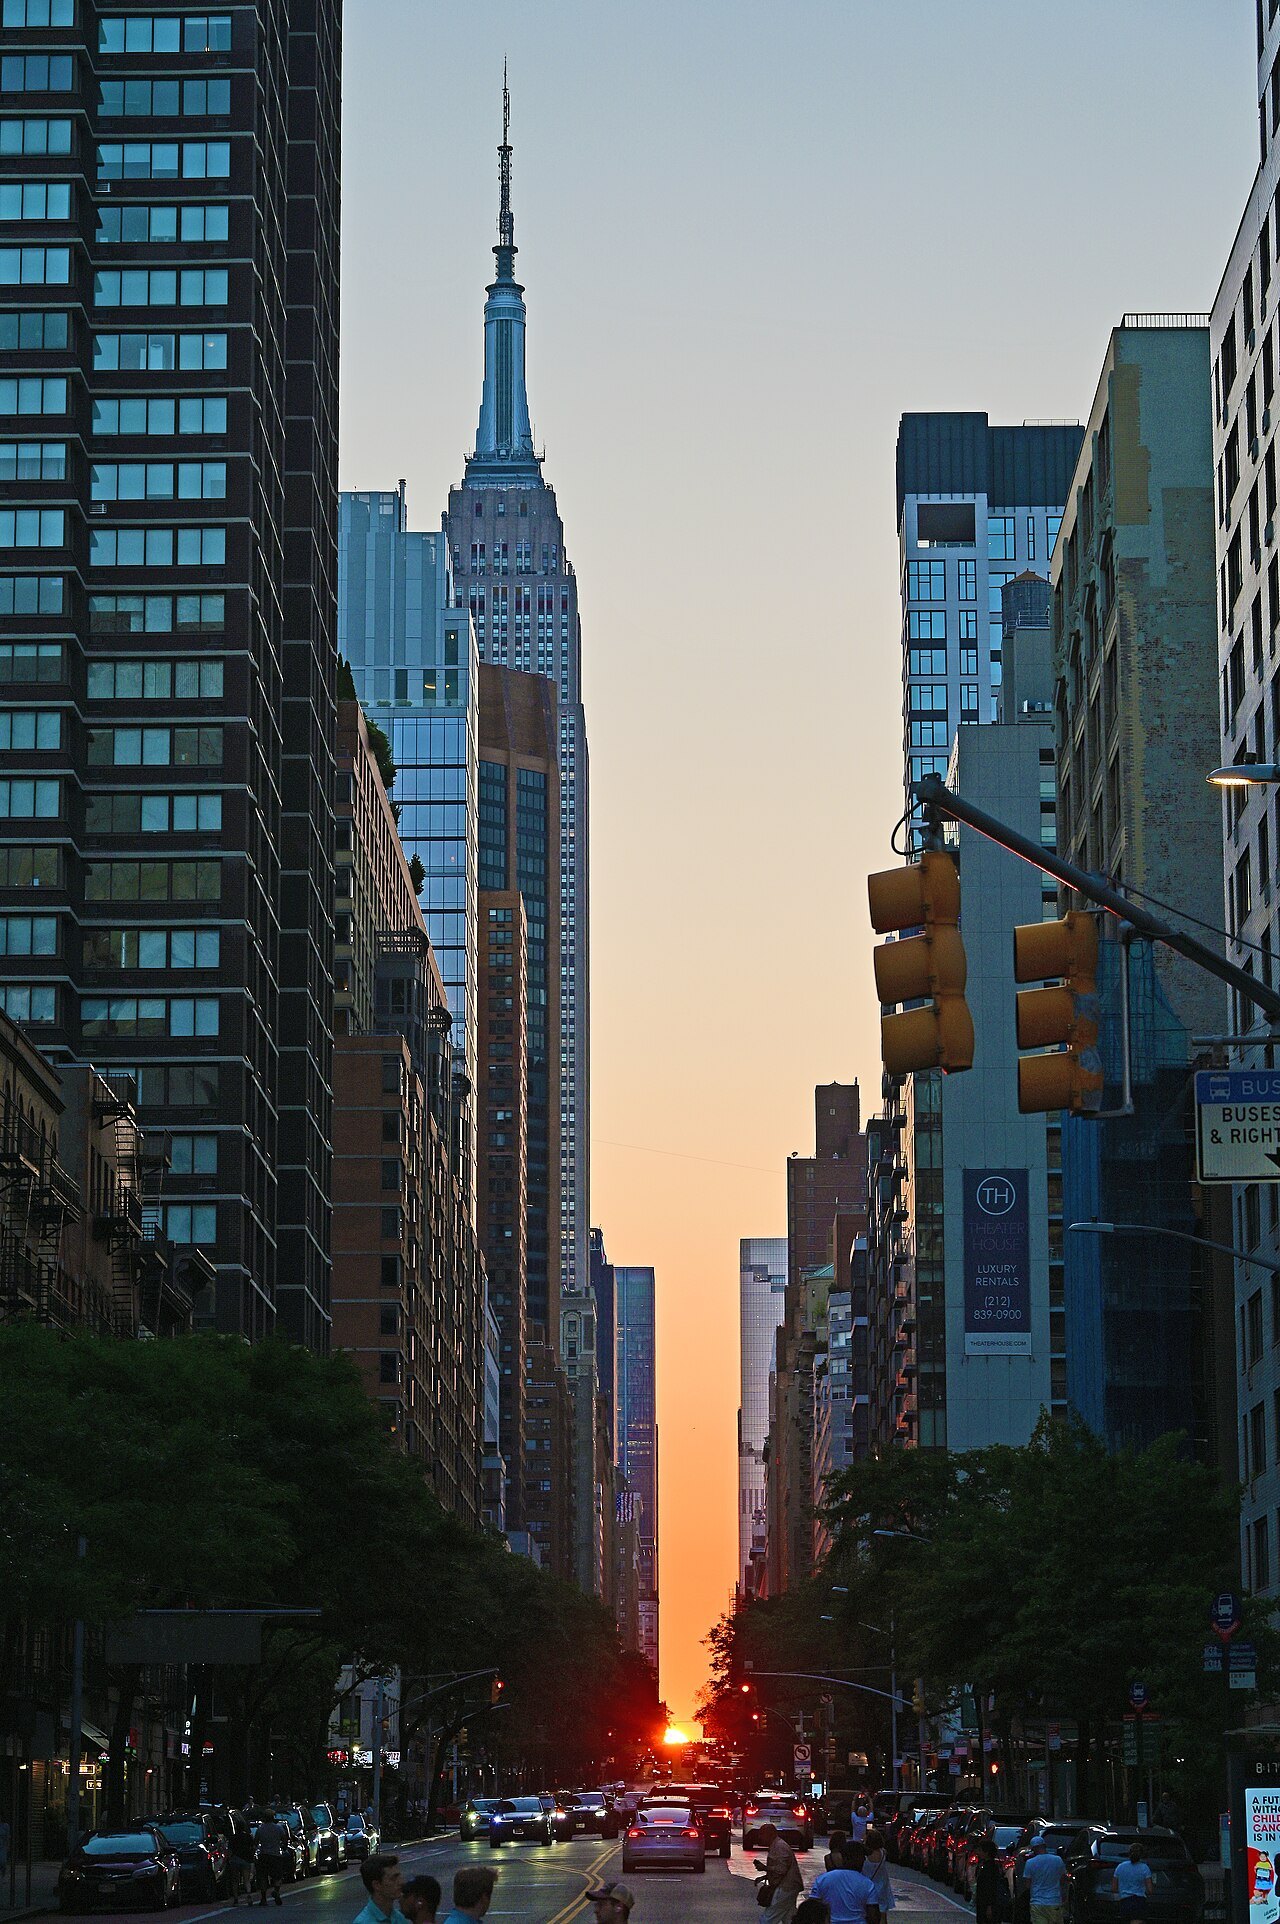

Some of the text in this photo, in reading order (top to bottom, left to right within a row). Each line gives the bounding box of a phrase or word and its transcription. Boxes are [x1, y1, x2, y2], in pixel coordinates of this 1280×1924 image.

[1242, 1079, 1280, 1095] BUS
[1222, 1106, 1280, 1123] BUSES
[1210, 1128, 1223, 1144] &
[982, 1187, 1009, 1204] TH
[969, 1222, 1026, 1235] THEATER
[972, 1238, 1021, 1251] HOUSE
[977, 1264, 1017, 1274] LUXURY
[975, 1277, 1020, 1286] RENTALS
[984, 1296, 1011, 1308] (212)
[973, 1309, 1022, 1320] 839-0900
[1252, 1796, 1260, 1804] A
[1253, 1833, 1276, 1842] IS IN
